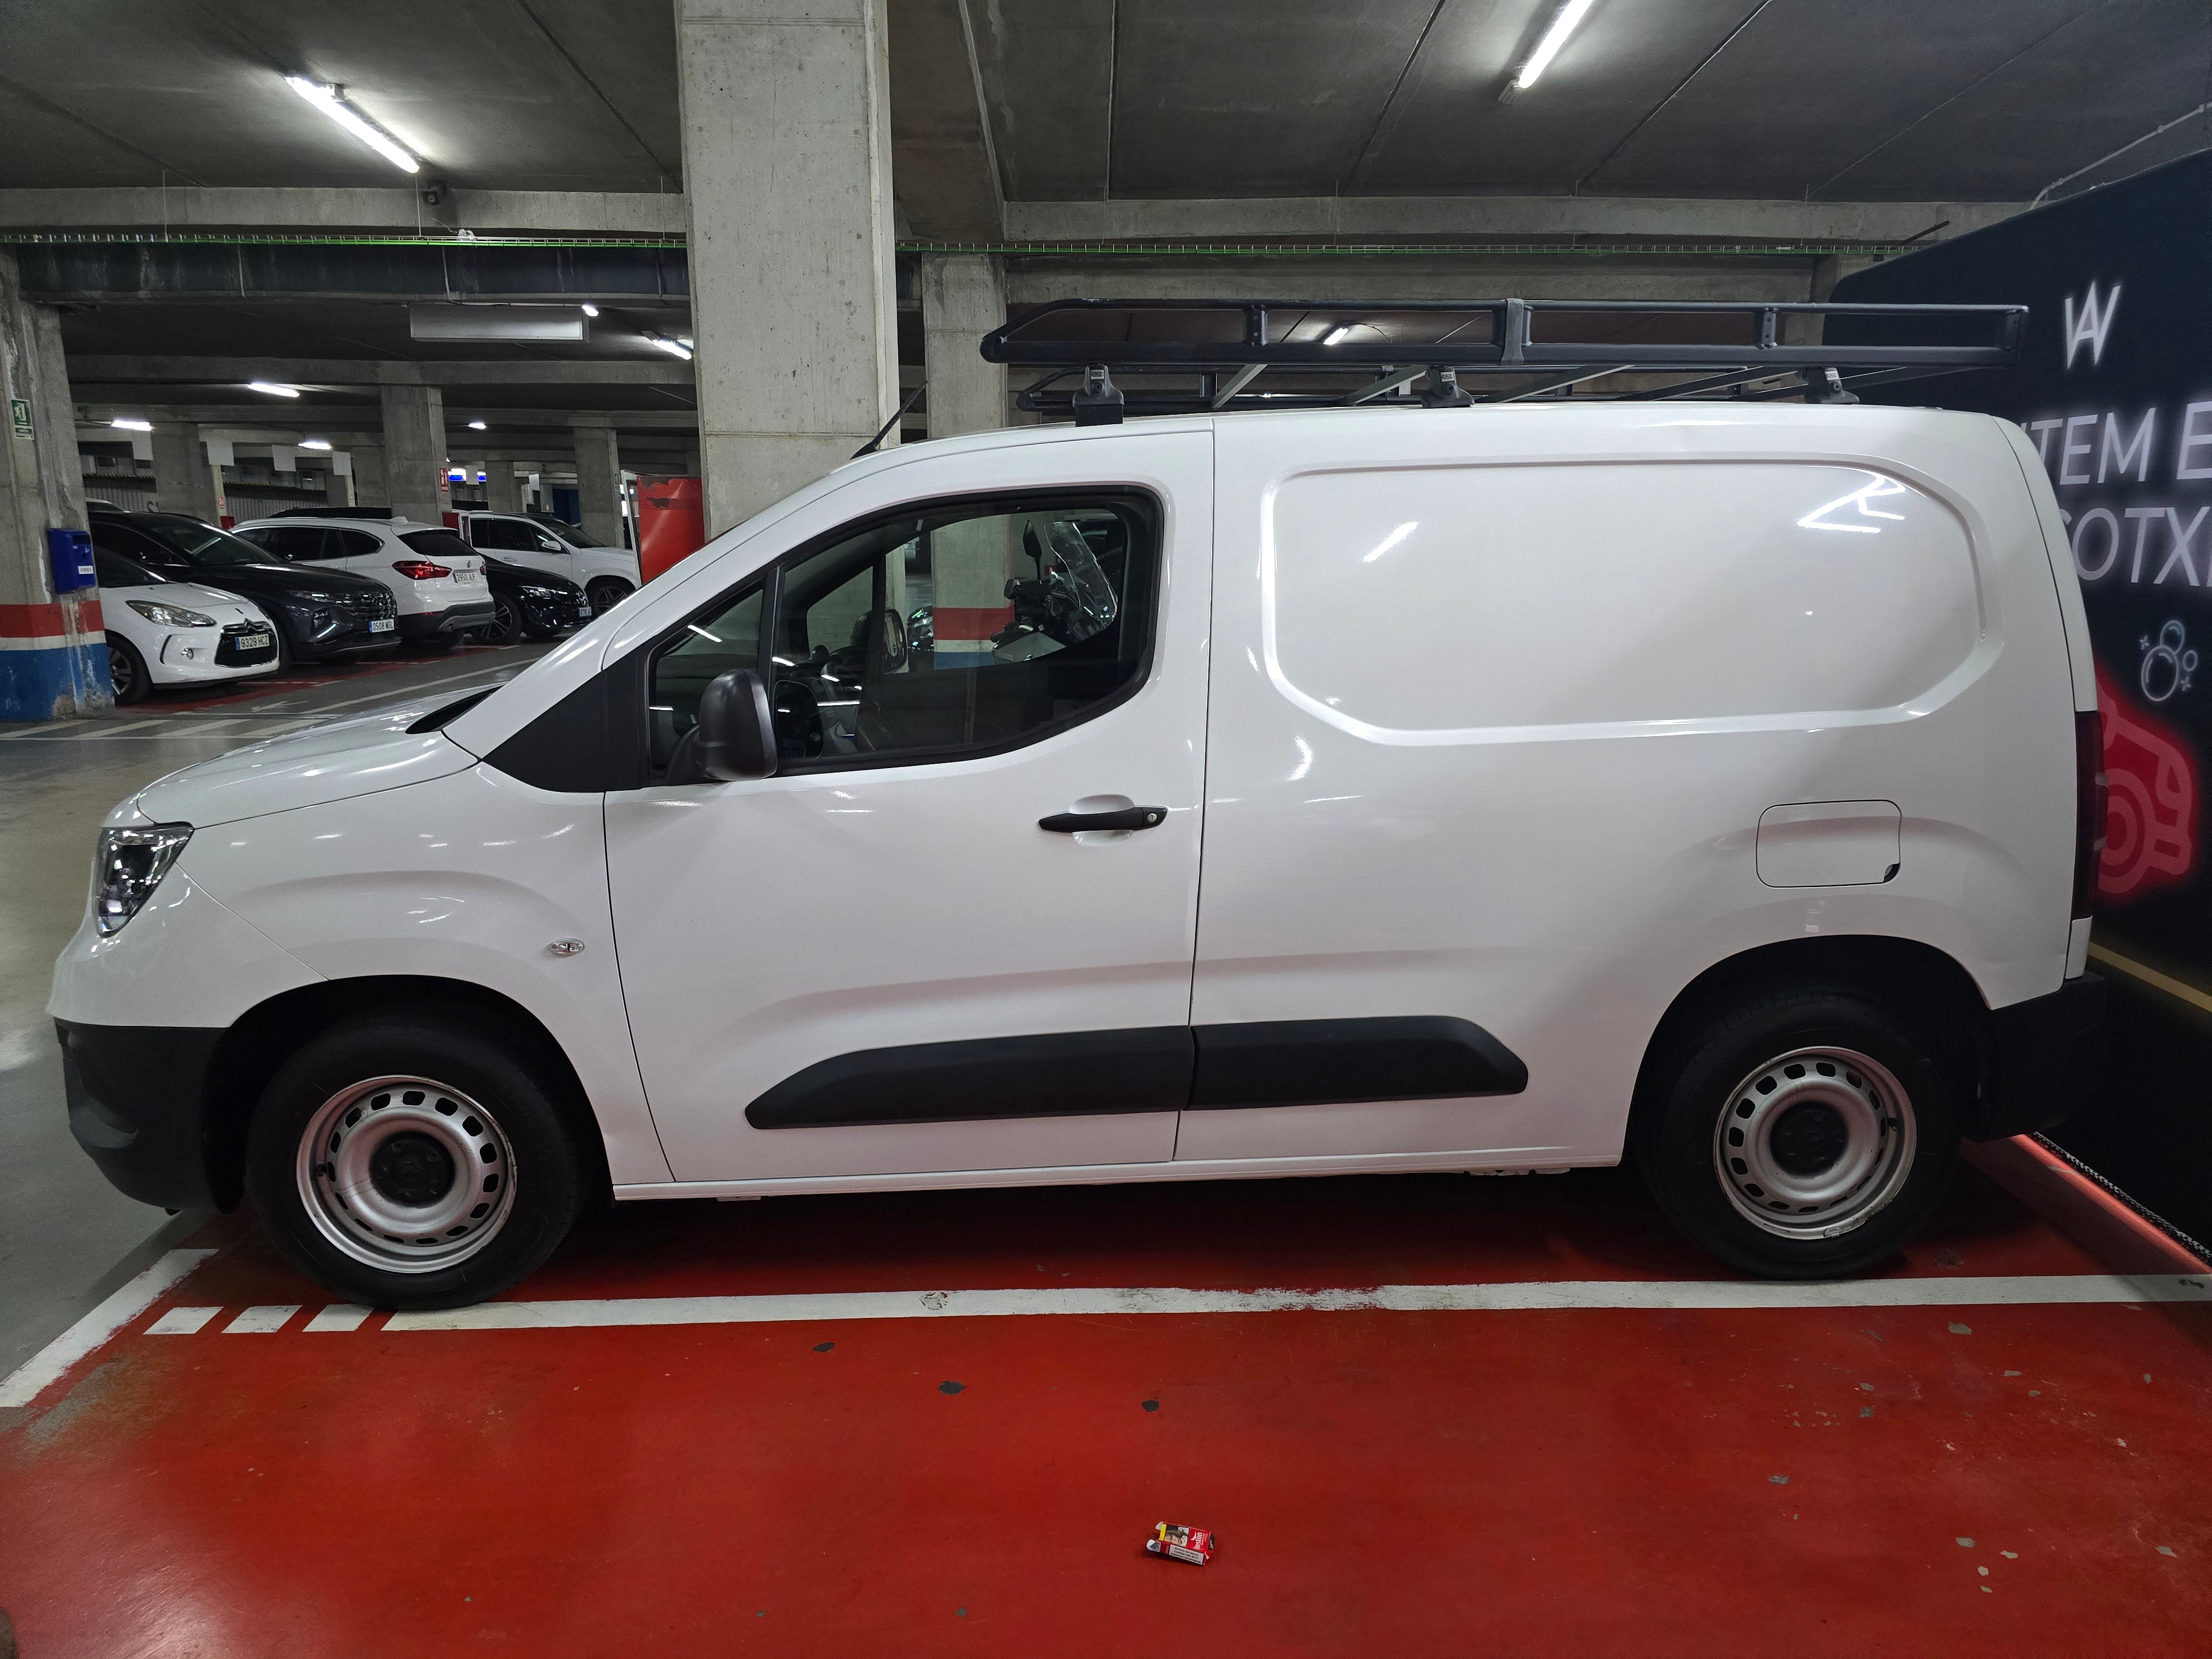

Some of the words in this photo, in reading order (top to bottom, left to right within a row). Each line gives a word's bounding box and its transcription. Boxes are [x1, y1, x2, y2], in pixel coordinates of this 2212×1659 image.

[2021, 407, 2157, 485] TEM
[2058, 506, 2212, 587] OTX
[241, 637, 257, 648] 9329
